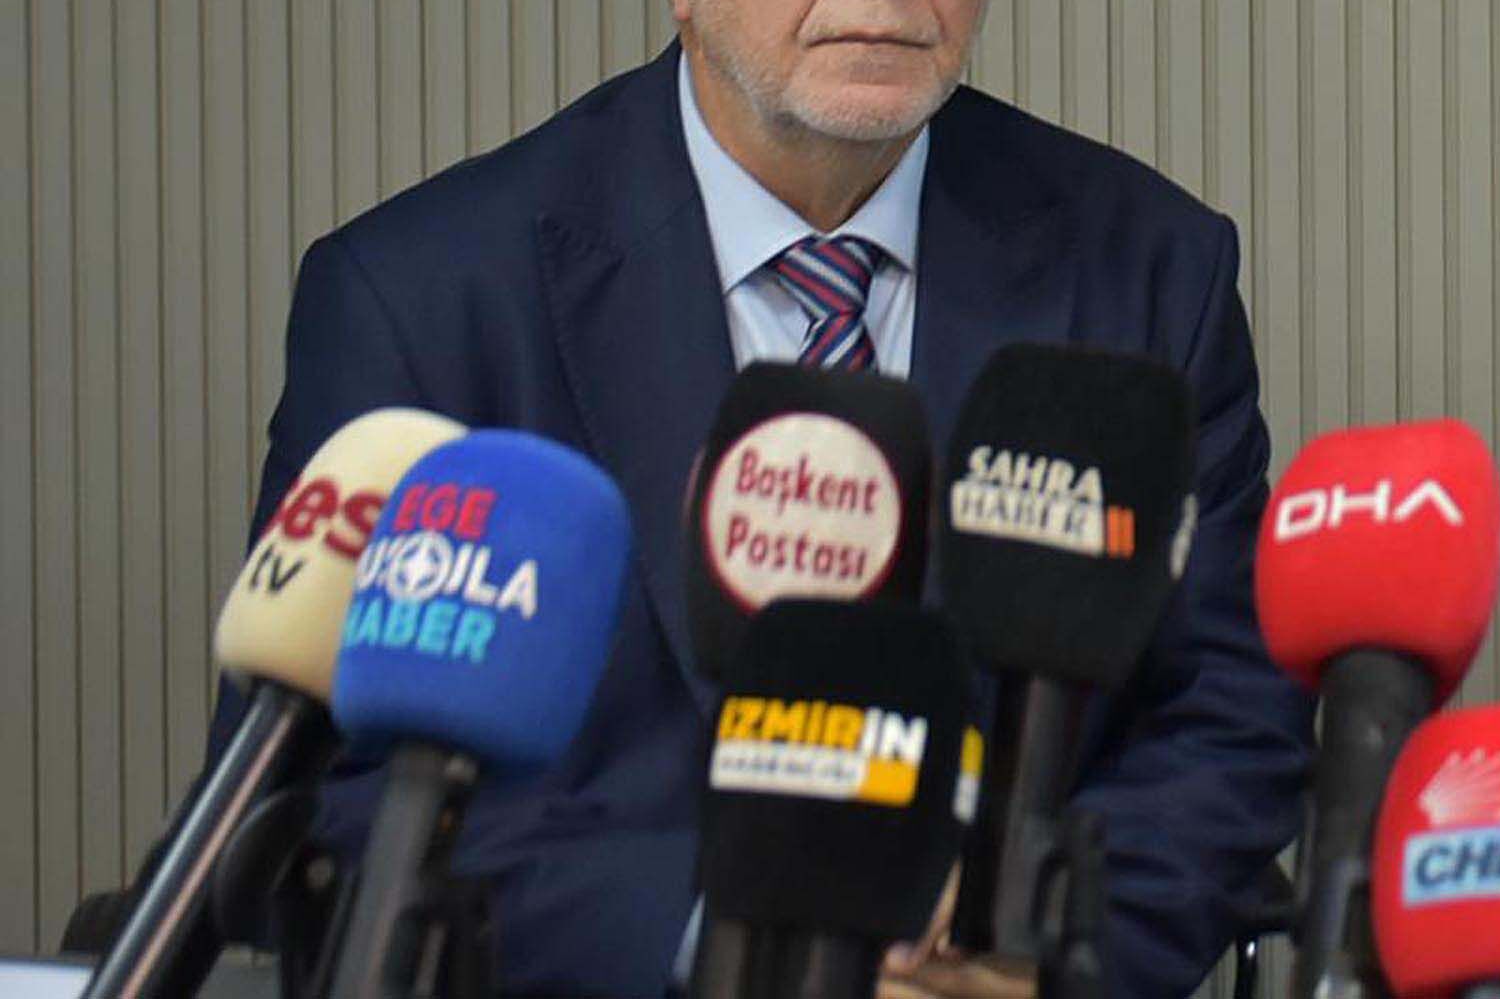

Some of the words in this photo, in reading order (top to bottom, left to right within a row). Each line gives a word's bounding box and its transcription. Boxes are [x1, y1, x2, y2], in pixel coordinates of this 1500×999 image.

[734, 448, 881, 515] Başkent
[968, 445, 1103, 503] SAHRA
[394, 484, 498, 541] EGE
[1276, 479, 1464, 542] DHA
[725, 516, 867, 580] Postası
